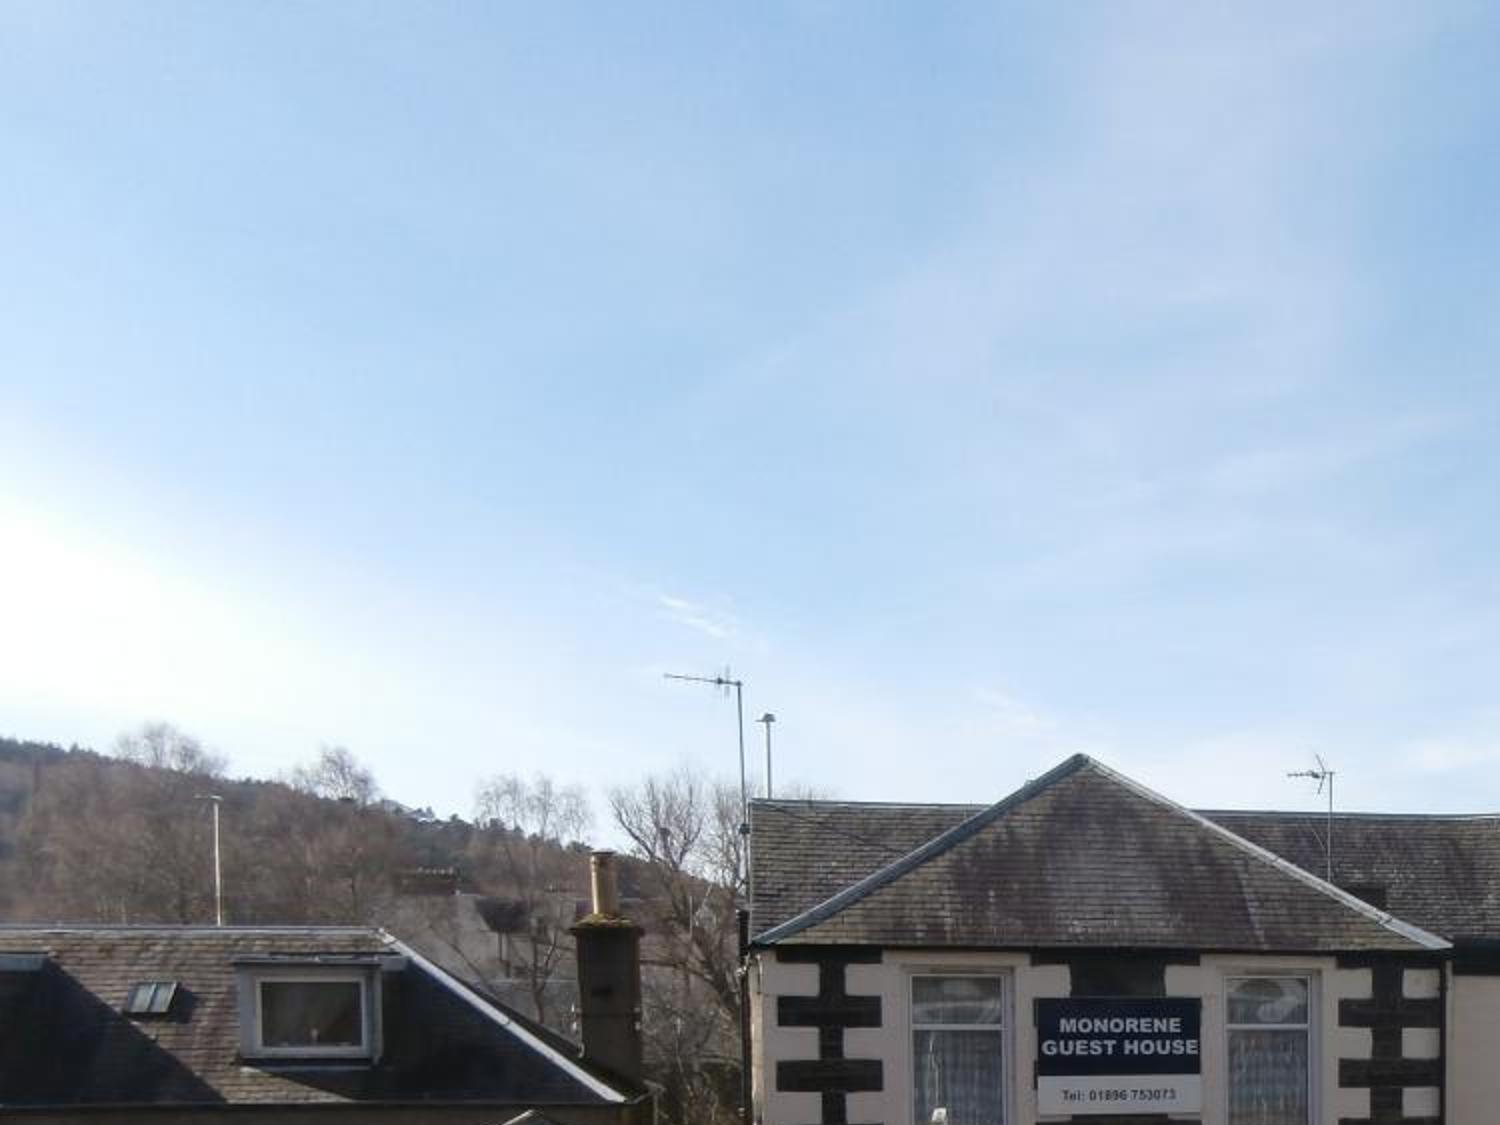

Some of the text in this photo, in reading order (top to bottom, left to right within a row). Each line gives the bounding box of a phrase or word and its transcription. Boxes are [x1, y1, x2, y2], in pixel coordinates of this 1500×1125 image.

[1059, 1017, 1181, 1033] MONORENE
[1041, 1039, 1198, 1055] GUEST HOUSE
[1062, 1089, 1085, 1101] Tel:
